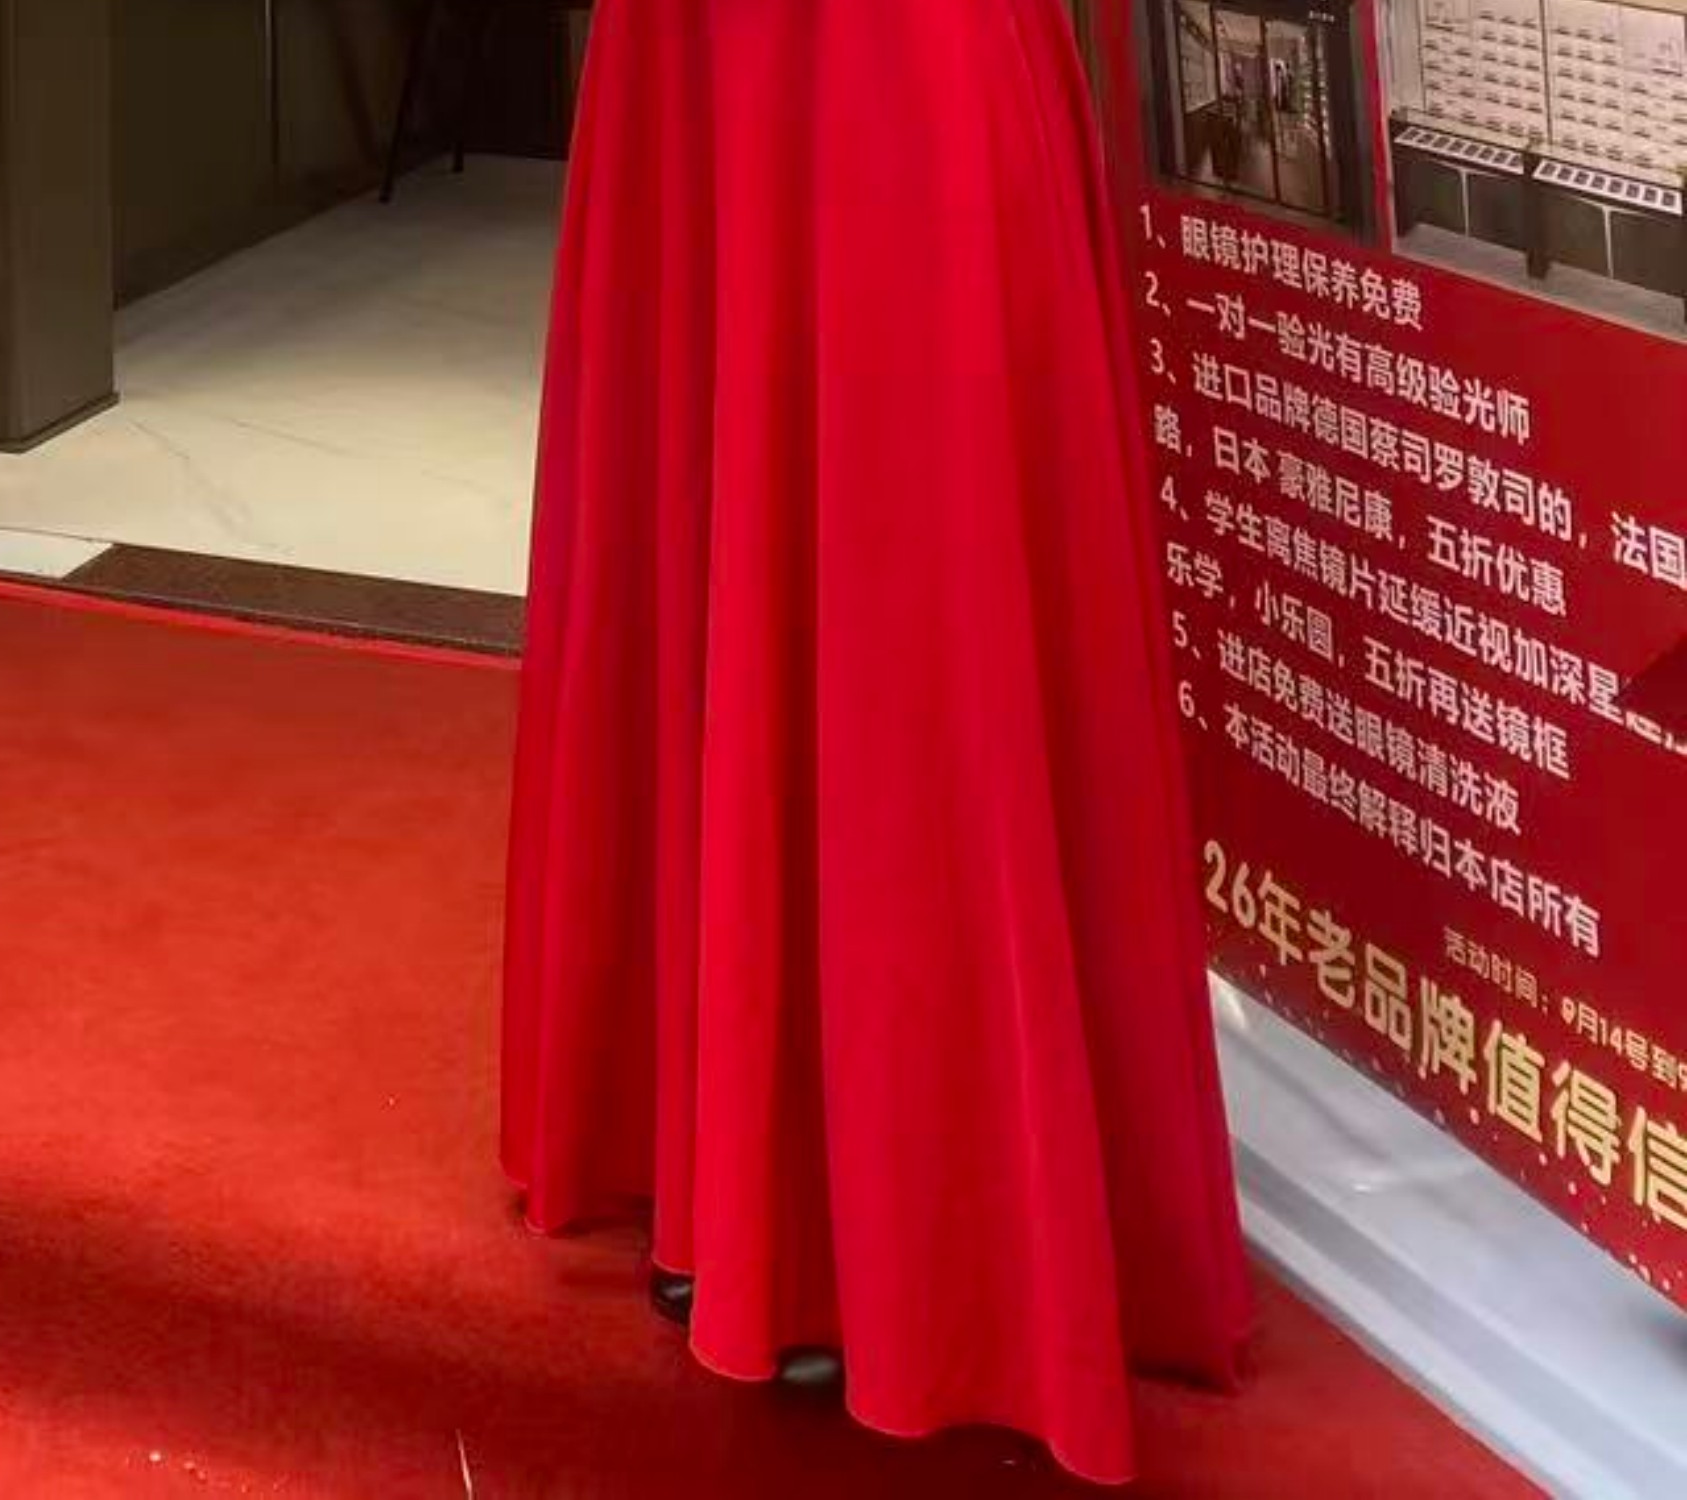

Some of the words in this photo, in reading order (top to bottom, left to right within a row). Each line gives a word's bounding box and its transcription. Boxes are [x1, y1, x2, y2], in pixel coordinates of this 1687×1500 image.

[1140, 204, 1423, 333] 1、眼镜护理保养免费
[1145, 270, 1530, 446] 2、一对一验光有高级验光师
[1160, 475, 1687, 756] 4、学生离焦镜片延缓近视加深星
[1172, 610, 1521, 836] 5、进店免费送眼镜清洗液
[1178, 680, 1600, 958] 6、本活动最终解释归本店所有
[1204, 840, 1687, 1231] 26年老品牌值得信
